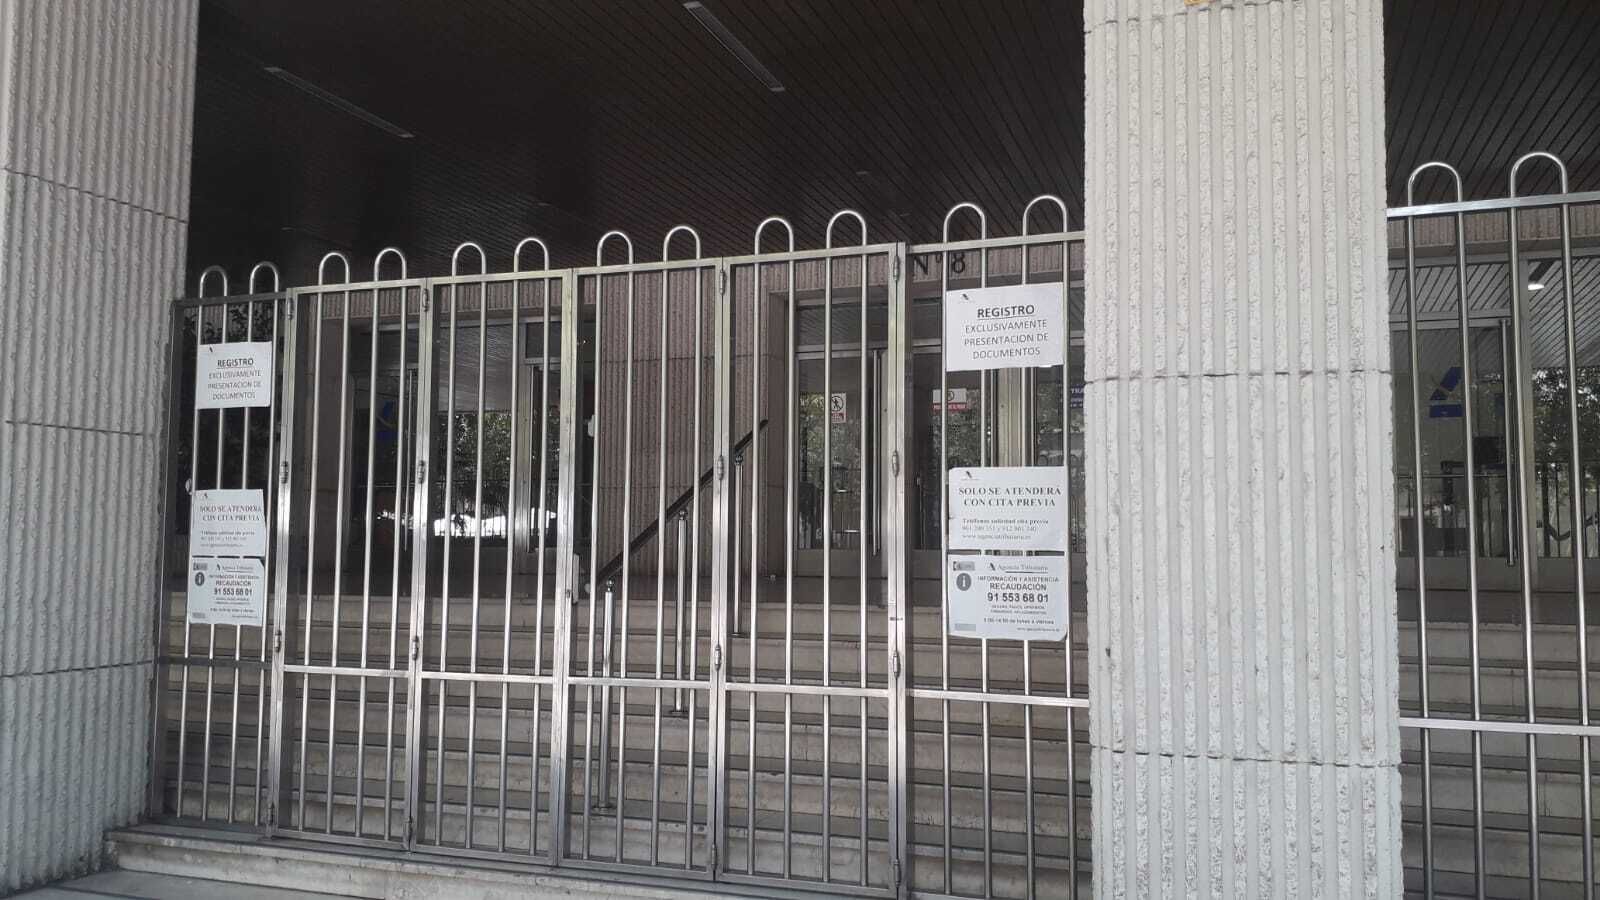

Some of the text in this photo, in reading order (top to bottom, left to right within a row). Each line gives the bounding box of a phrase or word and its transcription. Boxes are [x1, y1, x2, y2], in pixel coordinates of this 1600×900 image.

[952, 251, 966, 274] 8
[977, 305, 1035, 319] REGISTRO
[965, 319, 1048, 334] EXCLUSIVAMENTE
[1036, 333, 1049, 342] DE
[972, 347, 1041, 360] DOCUMENTOS
[217, 358, 254, 368] REGISTRO
[208, 370, 262, 380] EXCLUSIVAMENTE
[212, 392, 256, 400] DOCUMENTOS
[959, 487, 987, 496] SOLO
[988, 487, 1001, 496] SE
[963, 498, 1056, 507] CON CITA PREVIA
[214, 587, 221, 596] 91
[222, 587, 235, 596] 553
[244, 588, 253, 596] 01
[989, 582, 1047, 591] RECAUDACIÓN
[987, 592, 1049, 603] 91 553 68 01
